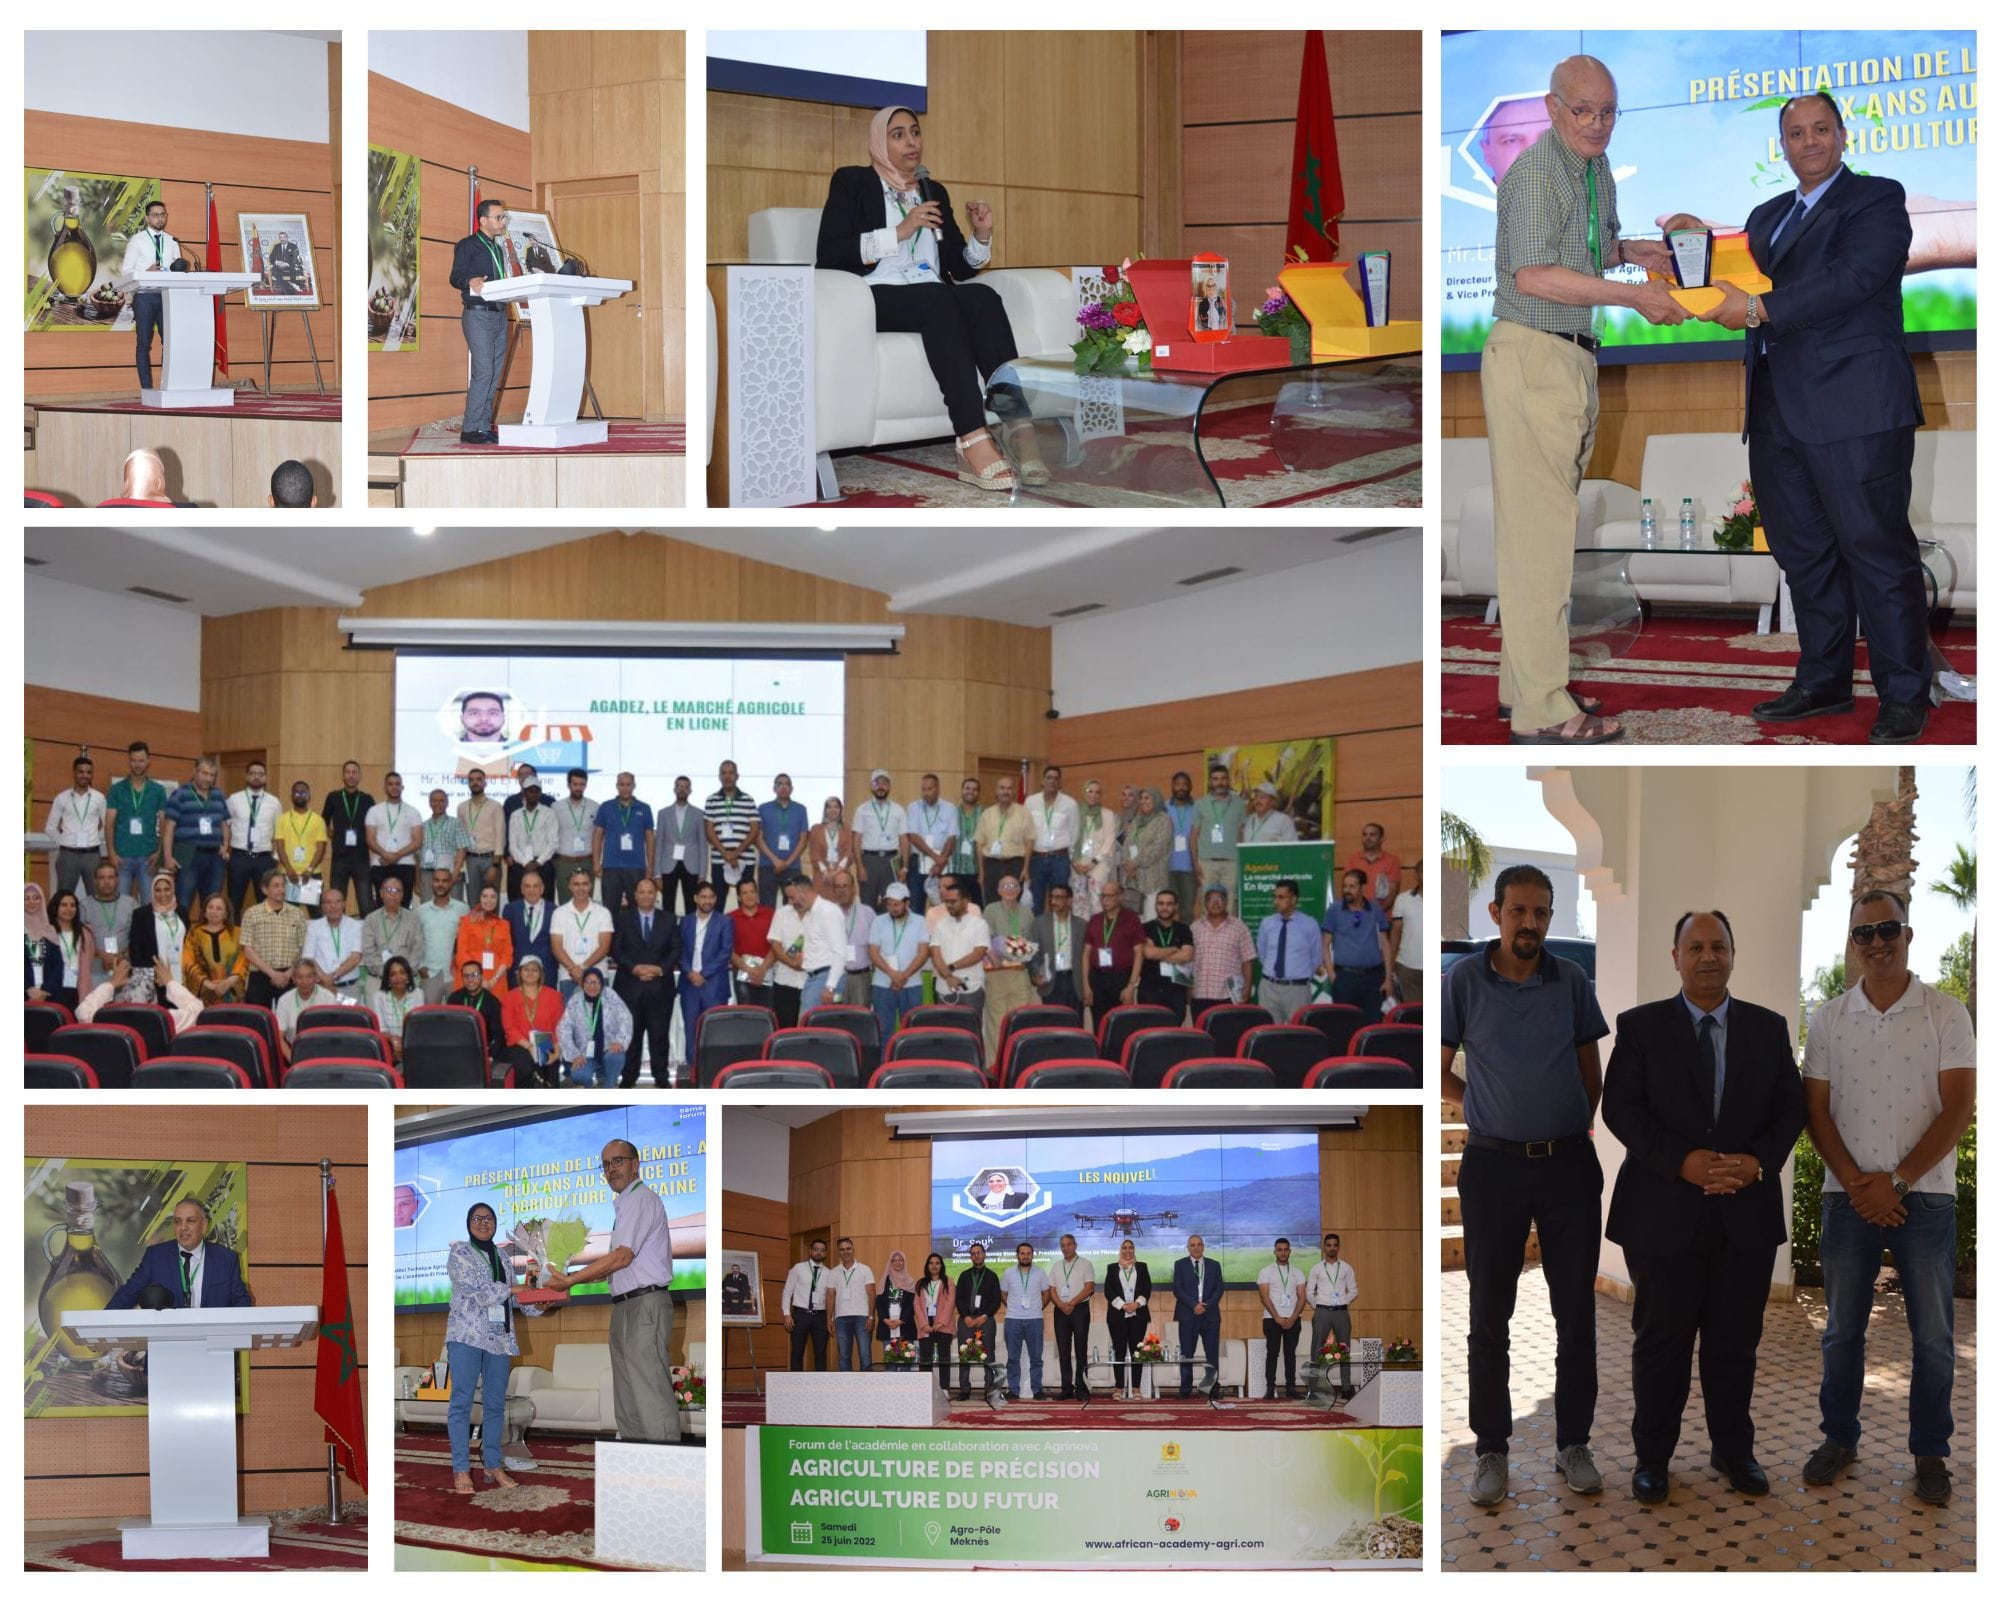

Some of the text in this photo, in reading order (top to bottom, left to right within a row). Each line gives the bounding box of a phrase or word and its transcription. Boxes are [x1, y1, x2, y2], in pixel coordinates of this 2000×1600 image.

[1689, 55, 1902, 104] PRÉSENTATION
[1913, 50, 1950, 79] DE
[1865, 87, 1927, 120] ANS
[1936, 83, 1976, 112] AU
[1446, 276, 1492, 286] Directeur
[1446, 291, 1454, 300] &
[1457, 290, 1479, 299] Vice
[589, 699, 806, 715] AGADEZ, LE MARCHÉ AGRICOLE
[667, 717, 729, 731] EN LIGNE
[464, 1161, 561, 1187] PRÉSENTATION
[564, 1158, 582, 1172] DE
[503, 1181, 538, 1198] DEUX
[542, 1177, 571, 1193] ANS
[575, 1173, 595, 1188] AU
[669, 1161, 689, 1177] DE
[1079, 1171, 1100, 1183] LES
[789, 1440, 1099, 1454] Forum de l'académie en collaboration avec Agrinova
[789, 1456, 1100, 1479] AGRICULTURE DE PRÉCISION
[790, 1489, 1059, 1510] AGRICULTURE DU FUTUR
[820, 1522, 857, 1532] Samedi
[950, 1525, 1001, 1536] Agro-Pôle
[820, 1535, 876, 1547] 25 juin 2022
[950, 1537, 989, 1546] Meknès
[1085, 1538, 1264, 1551] www.african-academy-agri.com
